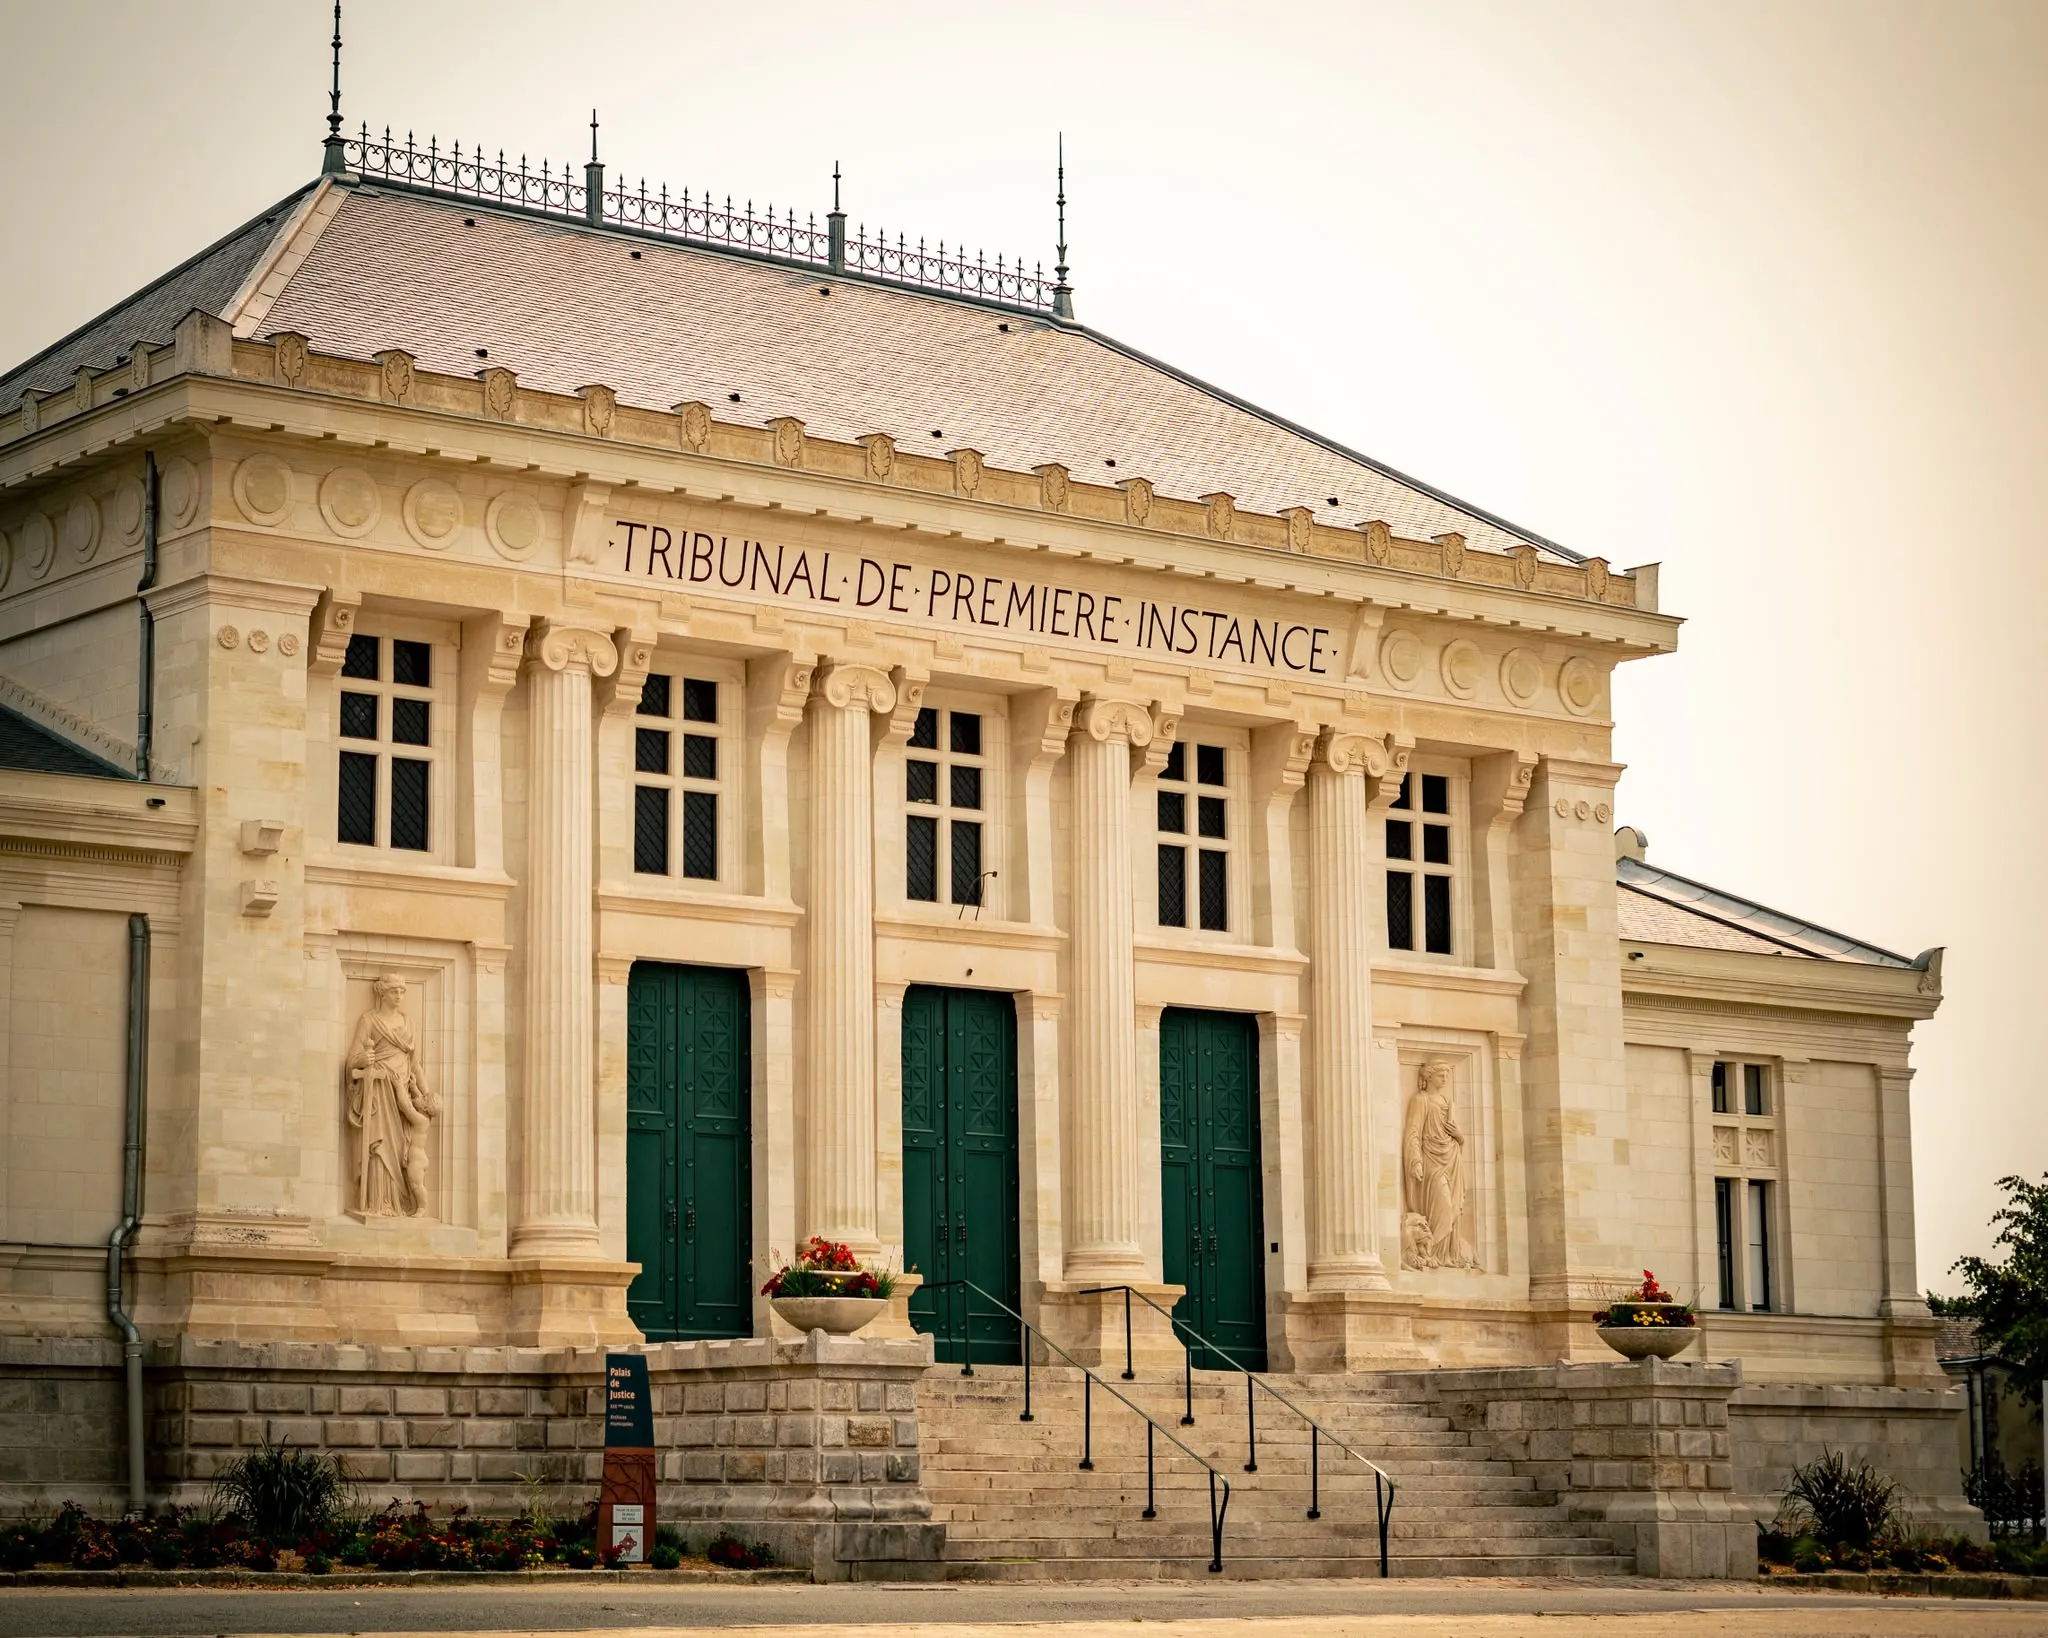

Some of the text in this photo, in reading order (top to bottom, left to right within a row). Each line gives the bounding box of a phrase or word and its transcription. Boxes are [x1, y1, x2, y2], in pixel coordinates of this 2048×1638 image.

[616, 520, 1330, 674] TRIBUNAL DE PREMIERE INSTANCE
[610, 1367, 631, 1377] Palais
[610, 1379, 620, 1388] de
[610, 1389, 635, 1400] Justice
